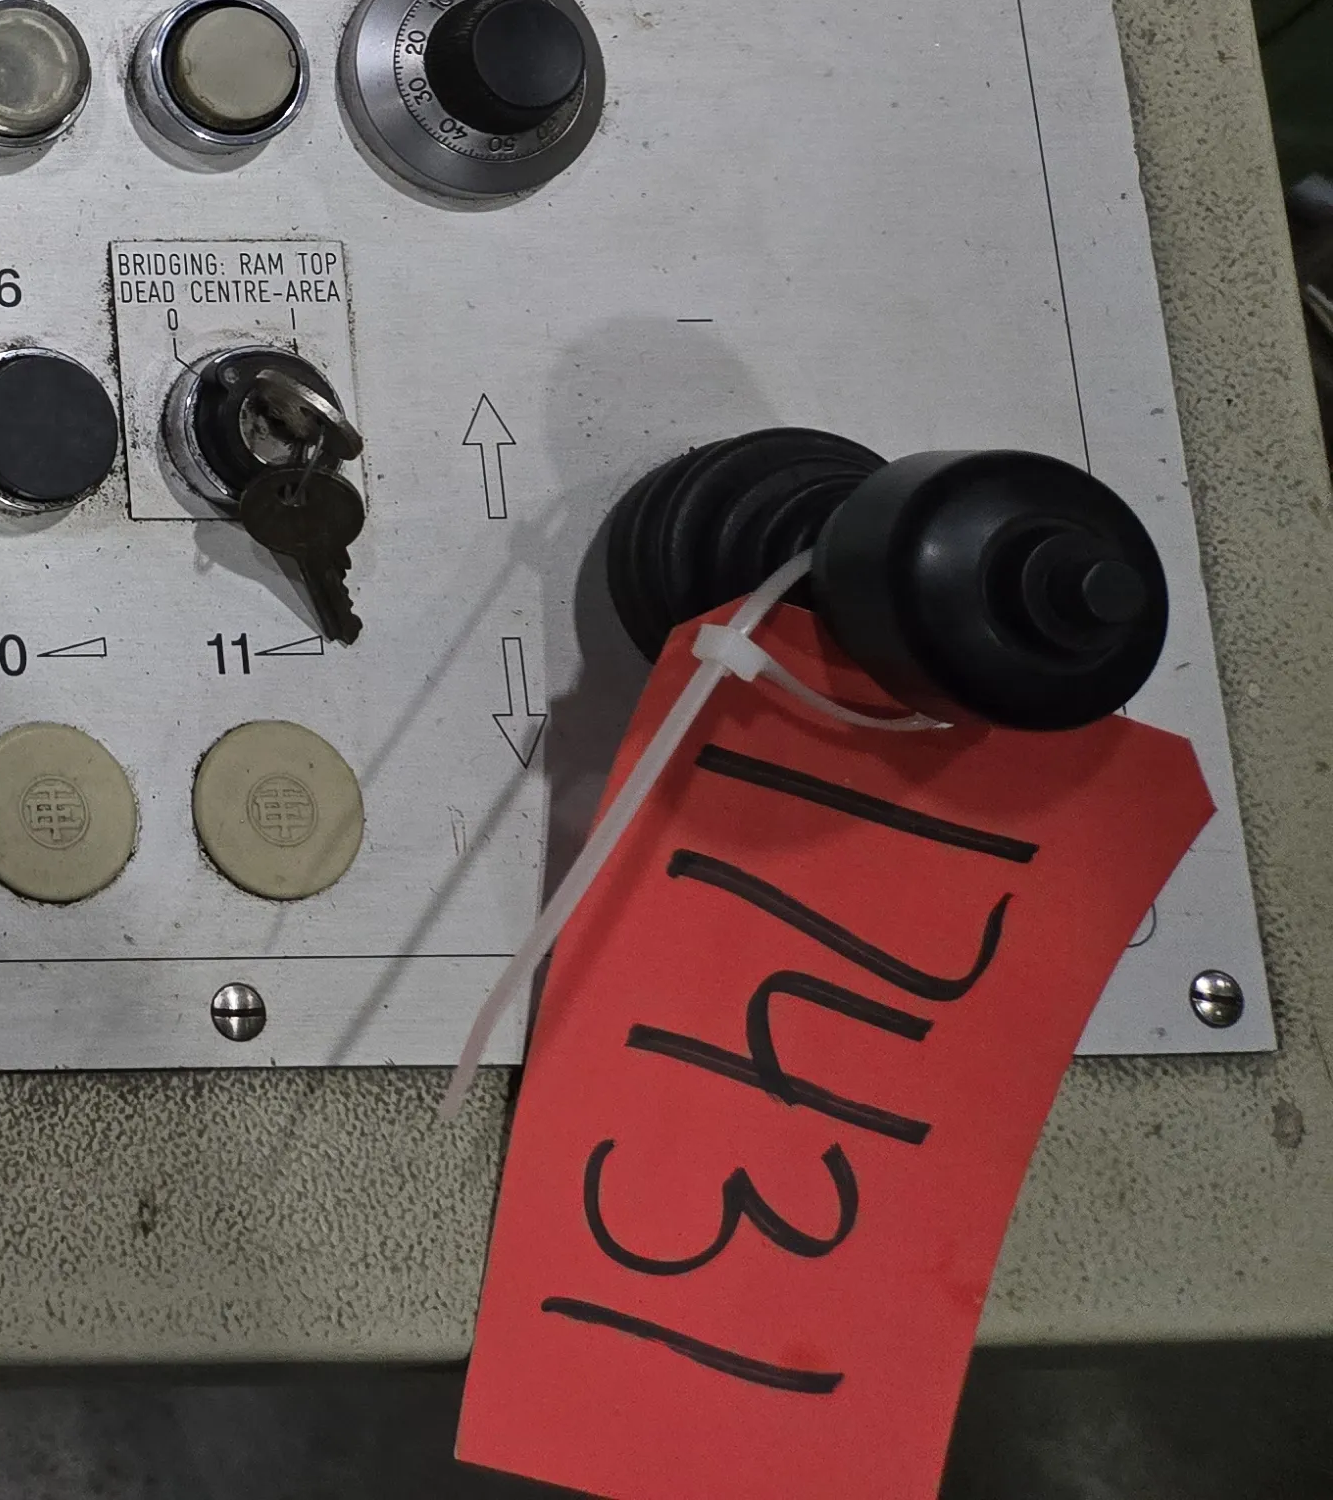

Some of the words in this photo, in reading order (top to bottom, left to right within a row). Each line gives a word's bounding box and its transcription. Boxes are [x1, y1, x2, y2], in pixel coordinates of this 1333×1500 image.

[405, 30, 427, 56] 20
[408, 78, 433, 106] 30
[439, 118, 468, 141] 40
[489, 137, 515, 152] 50
[118, 253, 226, 276] BRIDGING:
[240, 252, 284, 275] RAM
[297, 252, 337, 275] TOP
[120, 281, 175, 303] DEAD
[190, 280, 341, 303] CENTRE-AREA
[207, 632, 253, 676] 11
[539, 743, 1040, 1396] 17431
